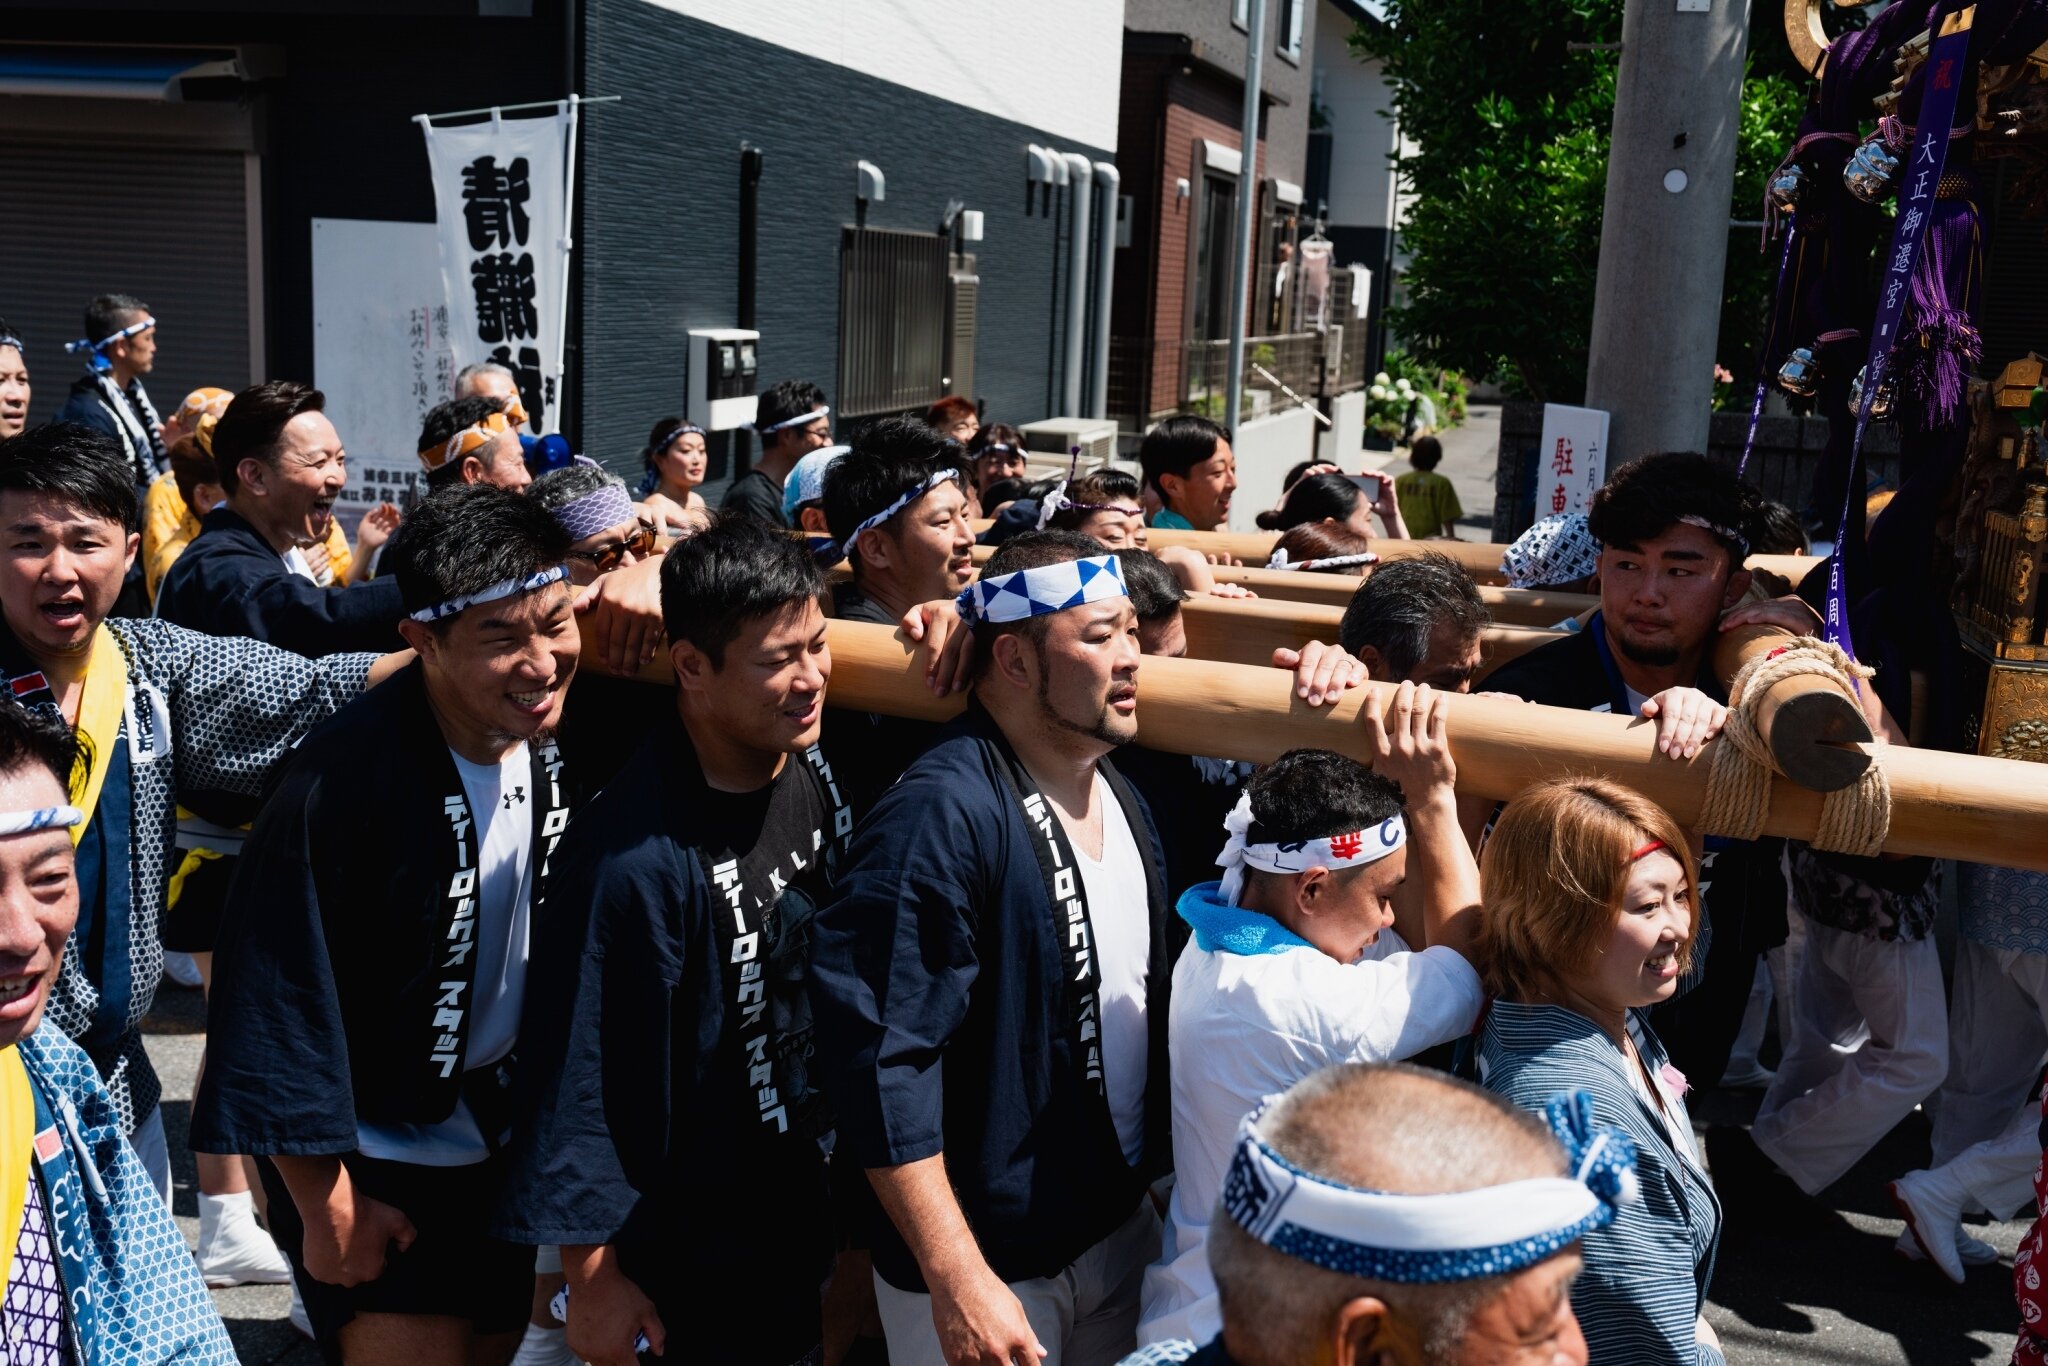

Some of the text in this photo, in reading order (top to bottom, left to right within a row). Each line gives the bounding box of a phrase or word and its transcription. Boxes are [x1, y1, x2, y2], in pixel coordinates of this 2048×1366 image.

[1886, 132, 1937, 309] 大正御遷宮
[1551, 437, 1574, 516] 駐車
[430, 794, 476, 1078] ティーロックス スタッフ
[712, 858, 788, 1133] ティーロックス スタッフ
